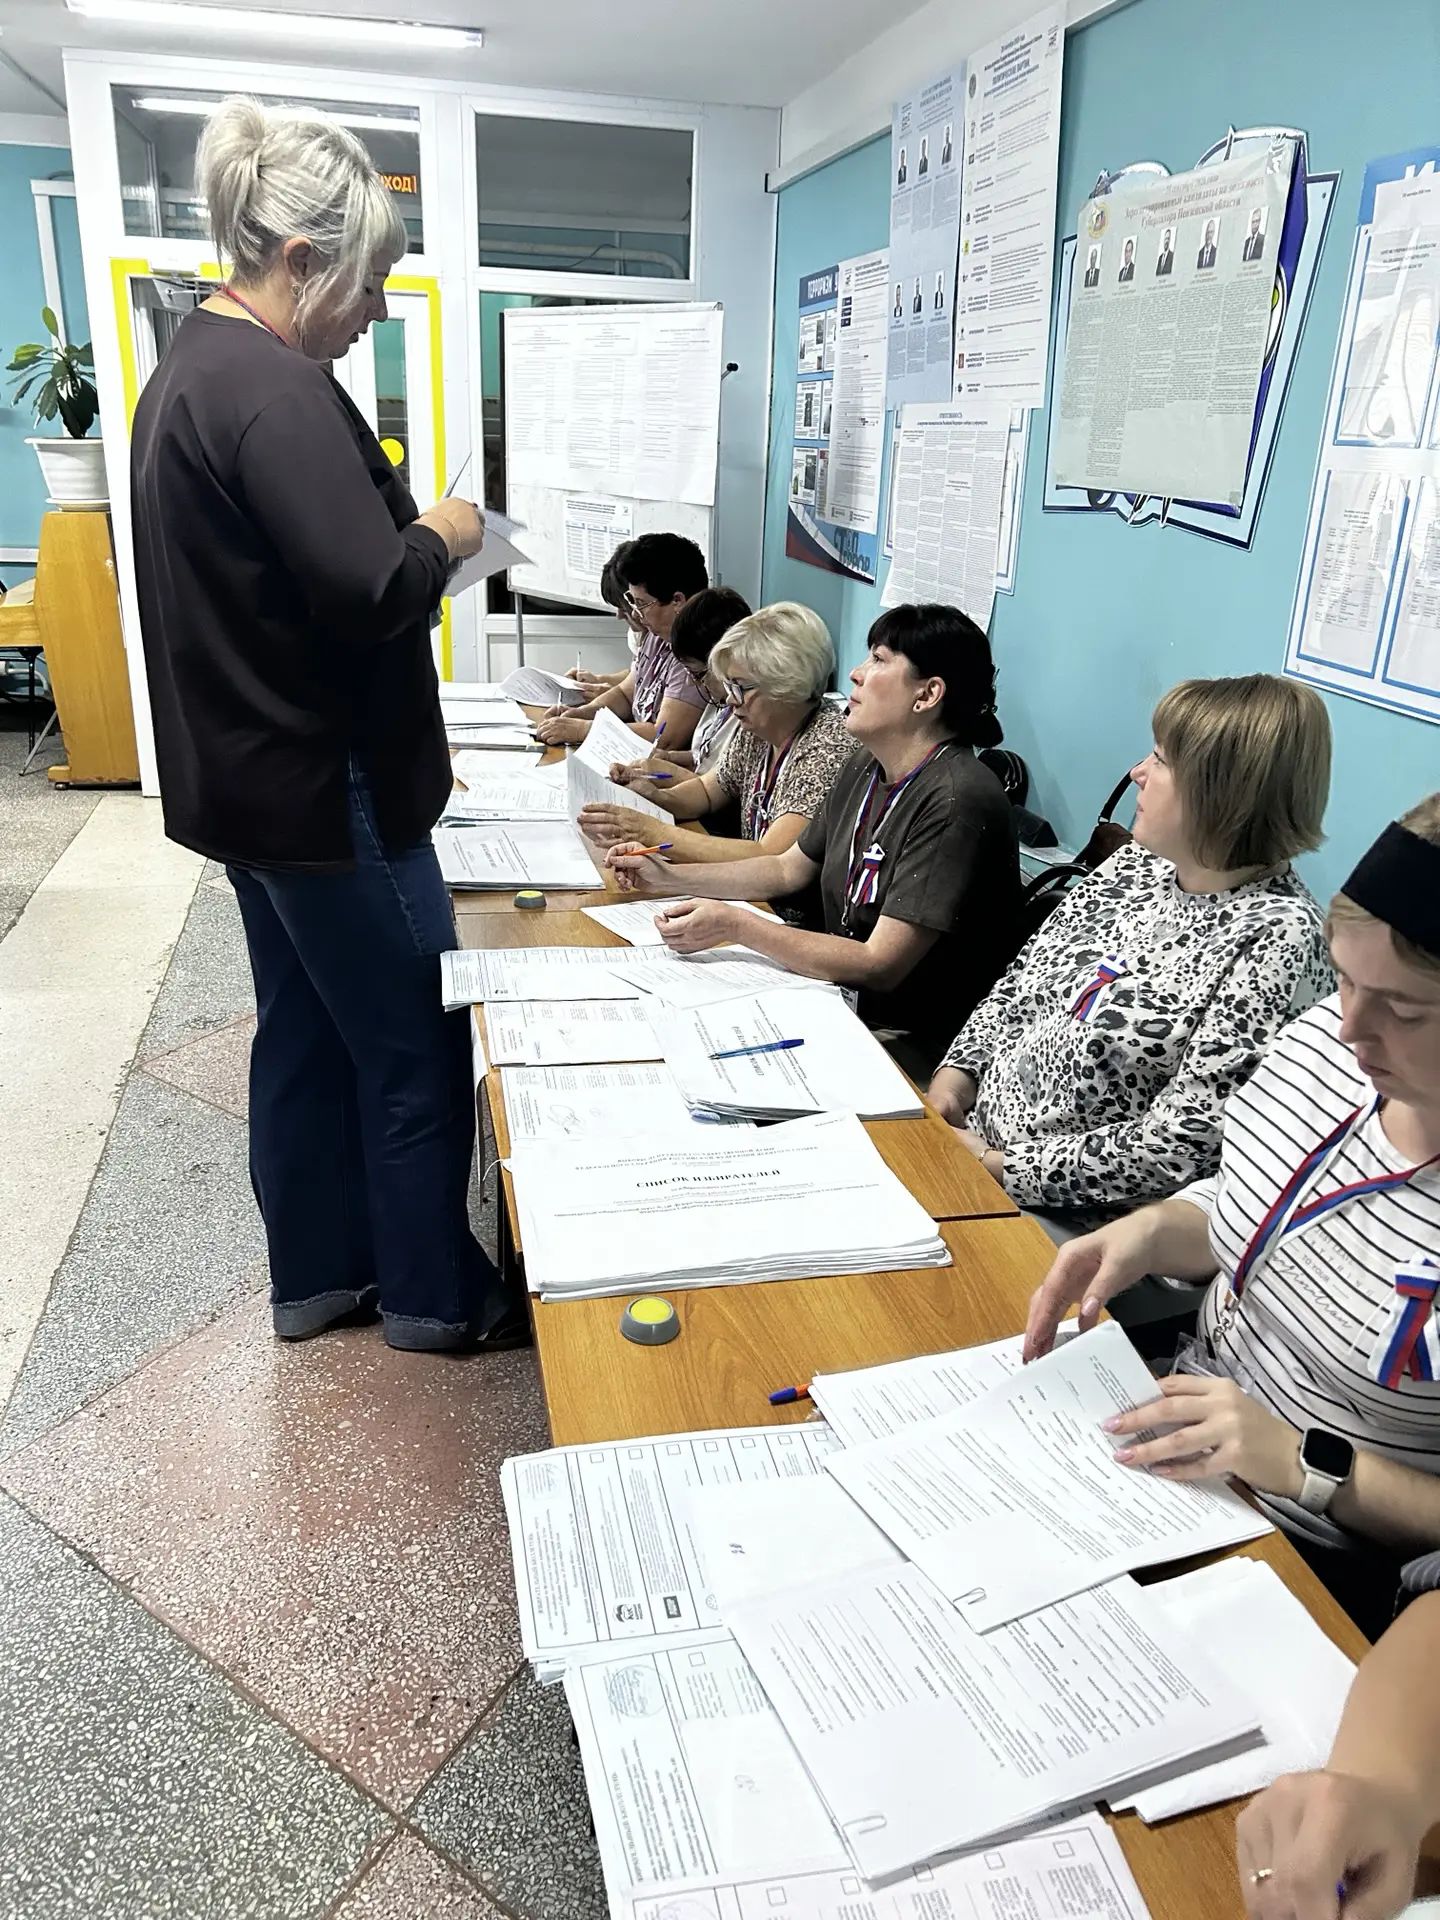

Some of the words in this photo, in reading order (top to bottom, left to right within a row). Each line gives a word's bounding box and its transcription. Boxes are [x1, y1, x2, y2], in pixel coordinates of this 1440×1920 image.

[380, 175, 413, 192] ХОД
[636, 1174, 690, 1188] СПИСОК
[692, 1168, 781, 1183] ИЗБИРАТЕЛЕЙ
[1311, 1264, 1331, 1283] YOUR
